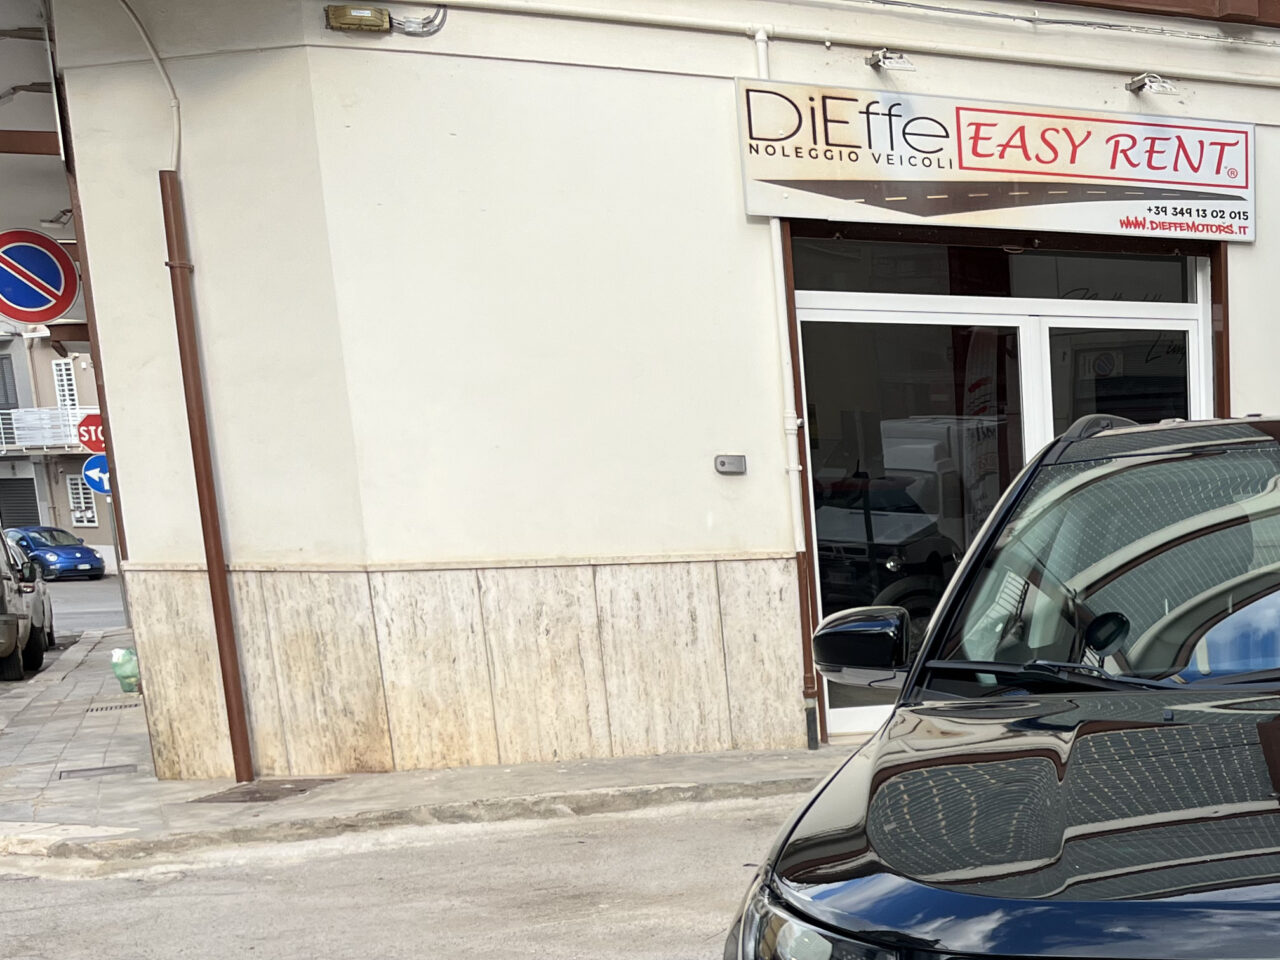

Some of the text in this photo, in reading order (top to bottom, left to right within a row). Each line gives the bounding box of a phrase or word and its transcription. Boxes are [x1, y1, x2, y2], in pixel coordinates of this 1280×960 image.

[745, 88, 950, 154] DiEffe
[748, 143, 953, 170] NOLEGGIO VEICOLI
[967, 121, 1239, 175] EASY RENT
[1146, 205, 1249, 221] +39 349 13 02 015
